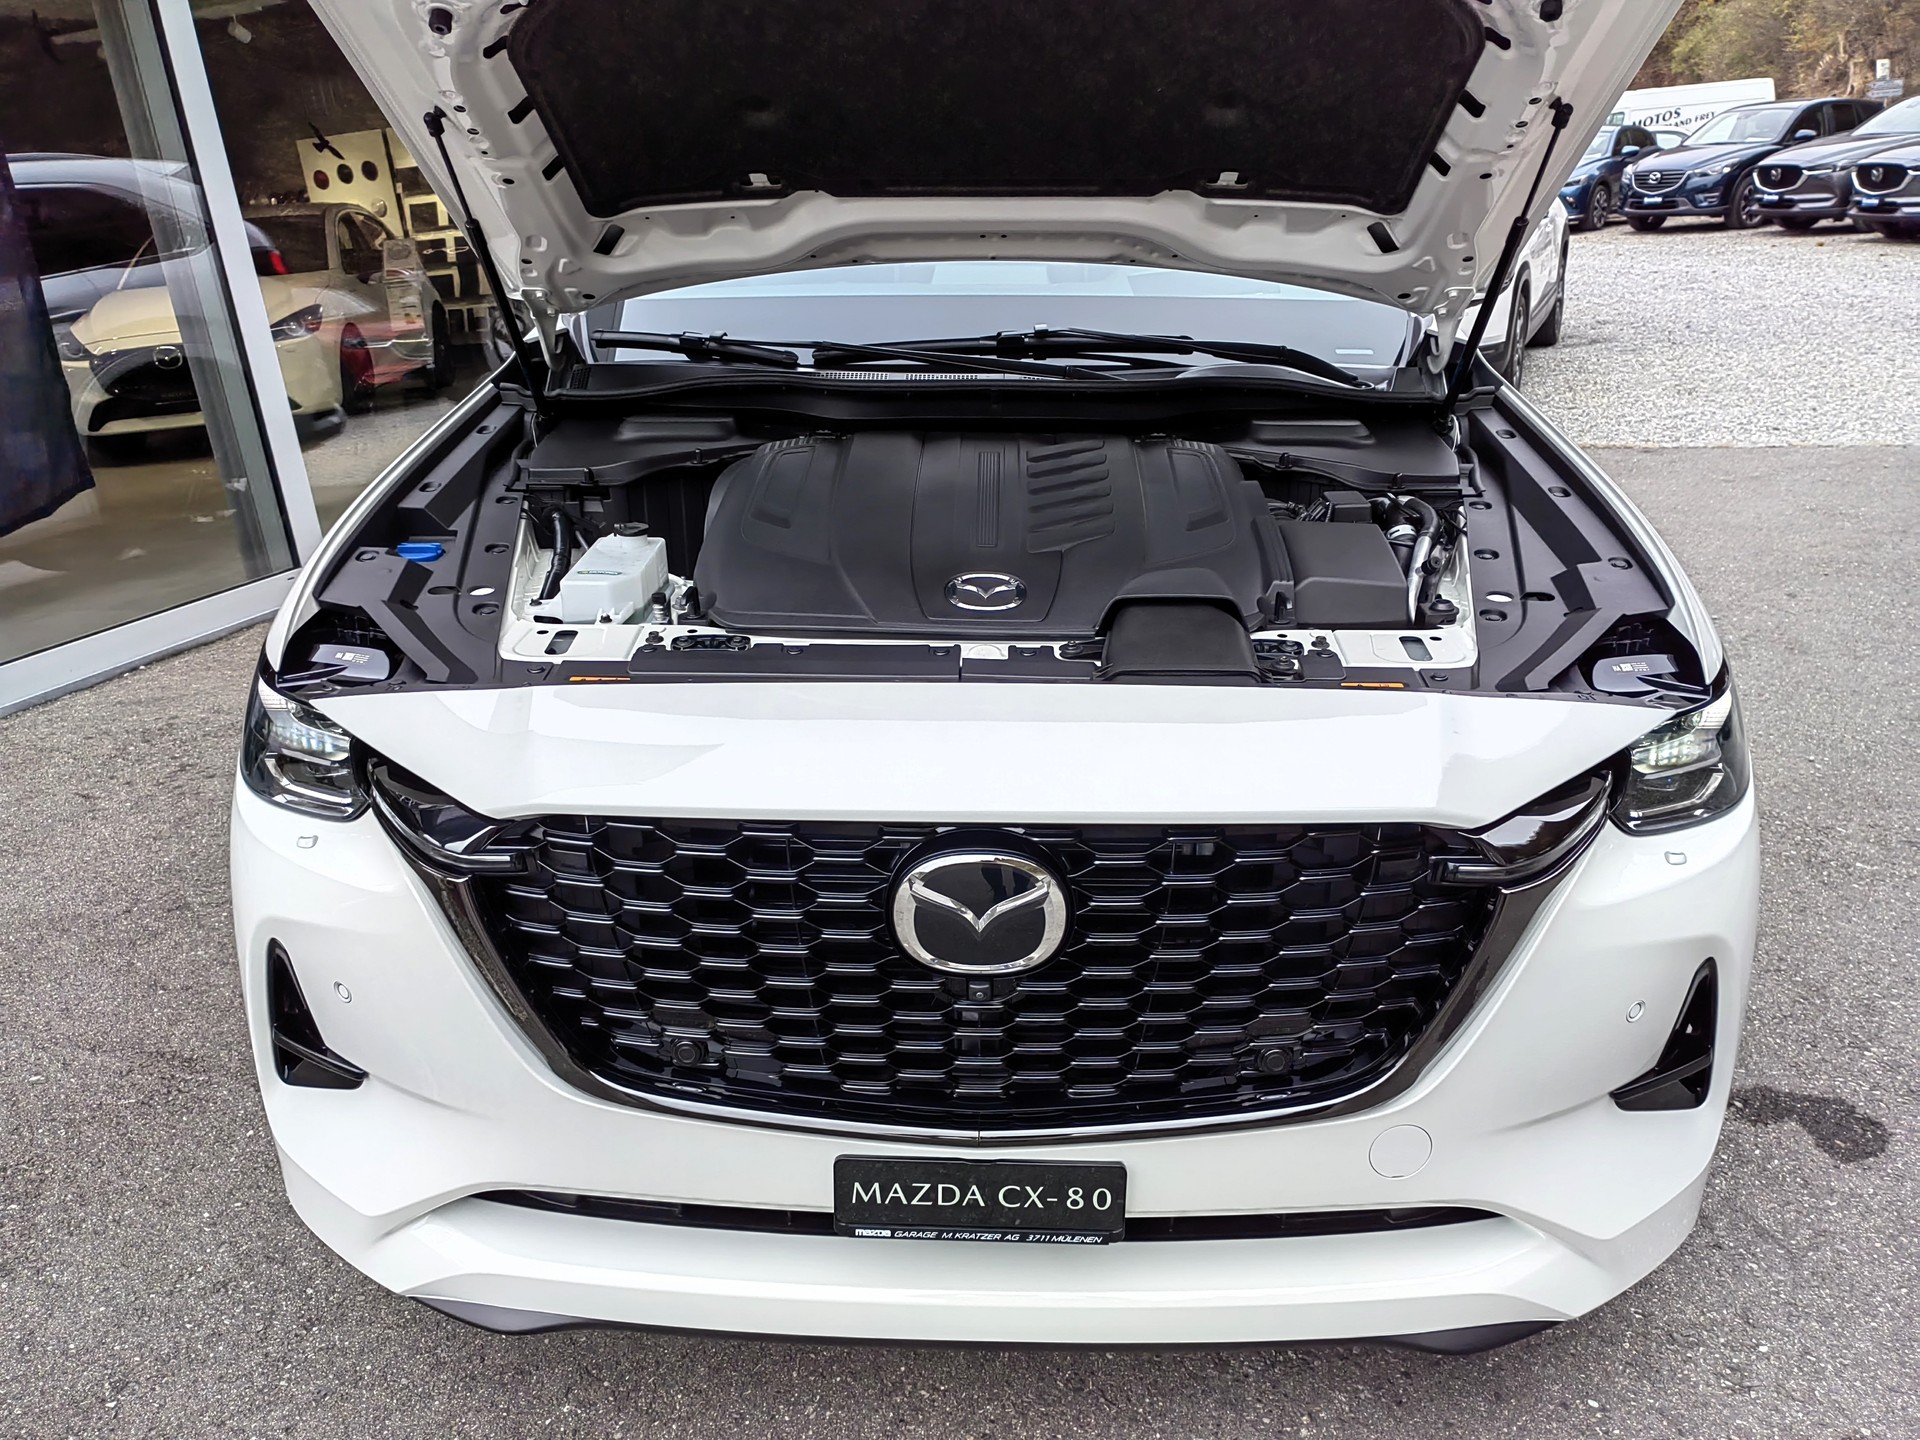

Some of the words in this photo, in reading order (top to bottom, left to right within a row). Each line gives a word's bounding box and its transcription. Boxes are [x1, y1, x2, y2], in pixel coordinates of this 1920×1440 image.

[851, 1181, 986, 1207] MAZDA
[997, 1185, 1113, 1211] CX-80
[894, 1230, 938, 1239] GARAGE
[1025, 1234, 1050, 1242] 3711
[1050, 1233, 1103, 1244] MÜLENEN
